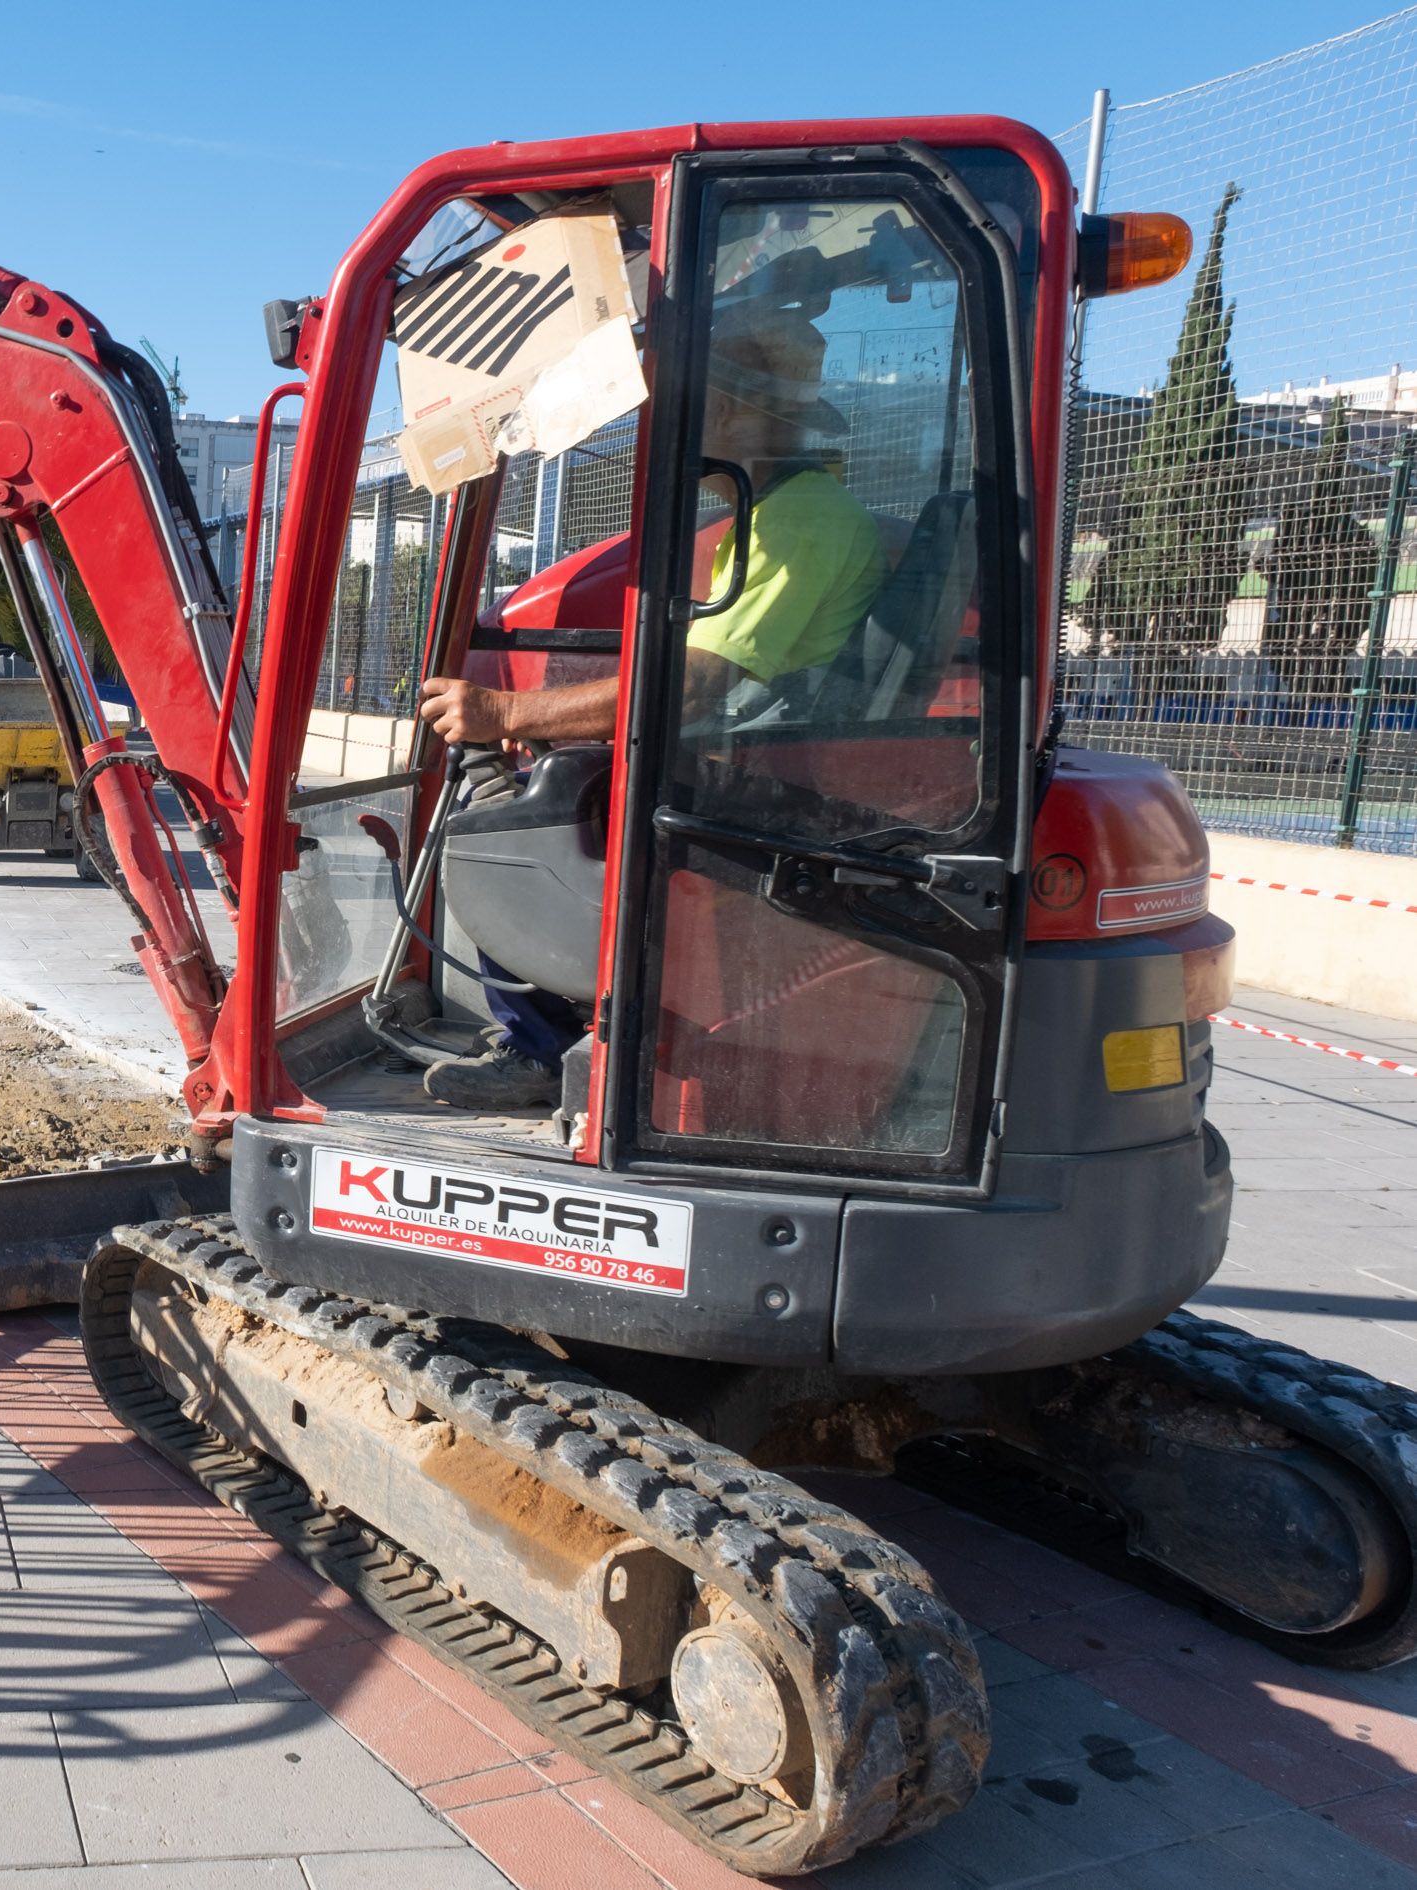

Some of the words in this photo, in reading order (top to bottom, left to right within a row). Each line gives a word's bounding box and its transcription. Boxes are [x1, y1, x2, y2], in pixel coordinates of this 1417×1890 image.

[1038, 867, 1075, 897] 01
[338, 1160, 660, 1249] KUPPER
[338, 1215, 483, 1252] www.kupper.es
[375, 1203, 460, 1229] ALQUILER
[465, 1218, 487, 1234] DE
[492, 1223, 614, 1255] MAQUINARIA
[543, 1251, 576, 1270] 956
[581, 1256, 603, 1275] 90
[606, 1261, 629, 1280] 78
[632, 1266, 656, 1285] 46
